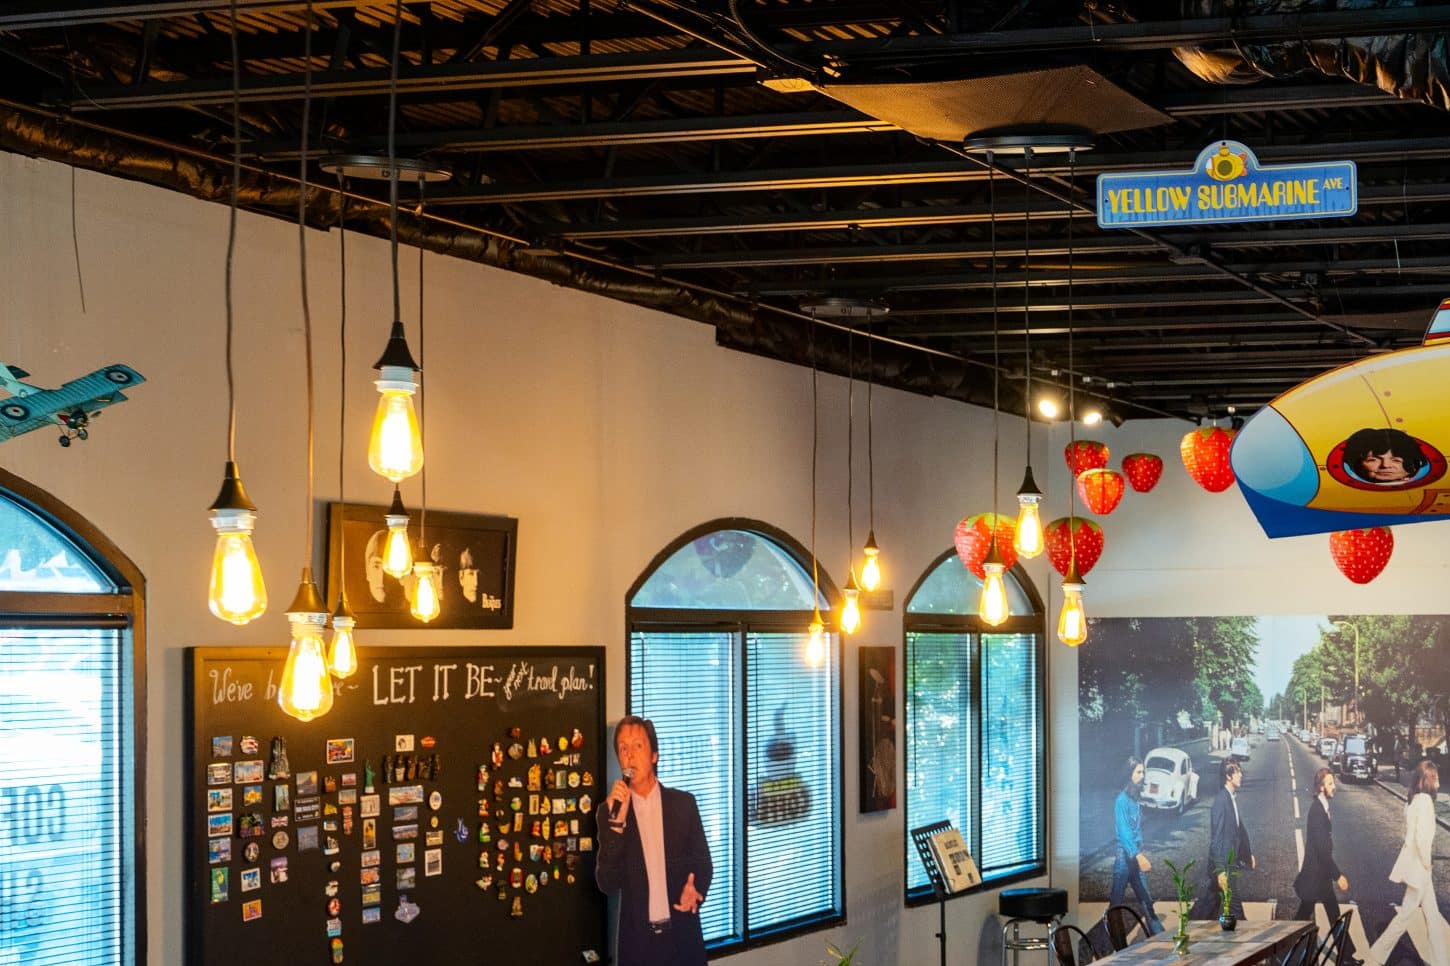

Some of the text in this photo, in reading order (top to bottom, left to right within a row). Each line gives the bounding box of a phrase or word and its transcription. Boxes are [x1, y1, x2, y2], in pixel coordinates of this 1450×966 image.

[1108, 185, 1192, 214] YELLOW
[1198, 178, 1320, 210] SUBMARINE
[208, 666, 253, 705] We've
[372, 664, 424, 705] LET
[432, 663, 458, 701] IT
